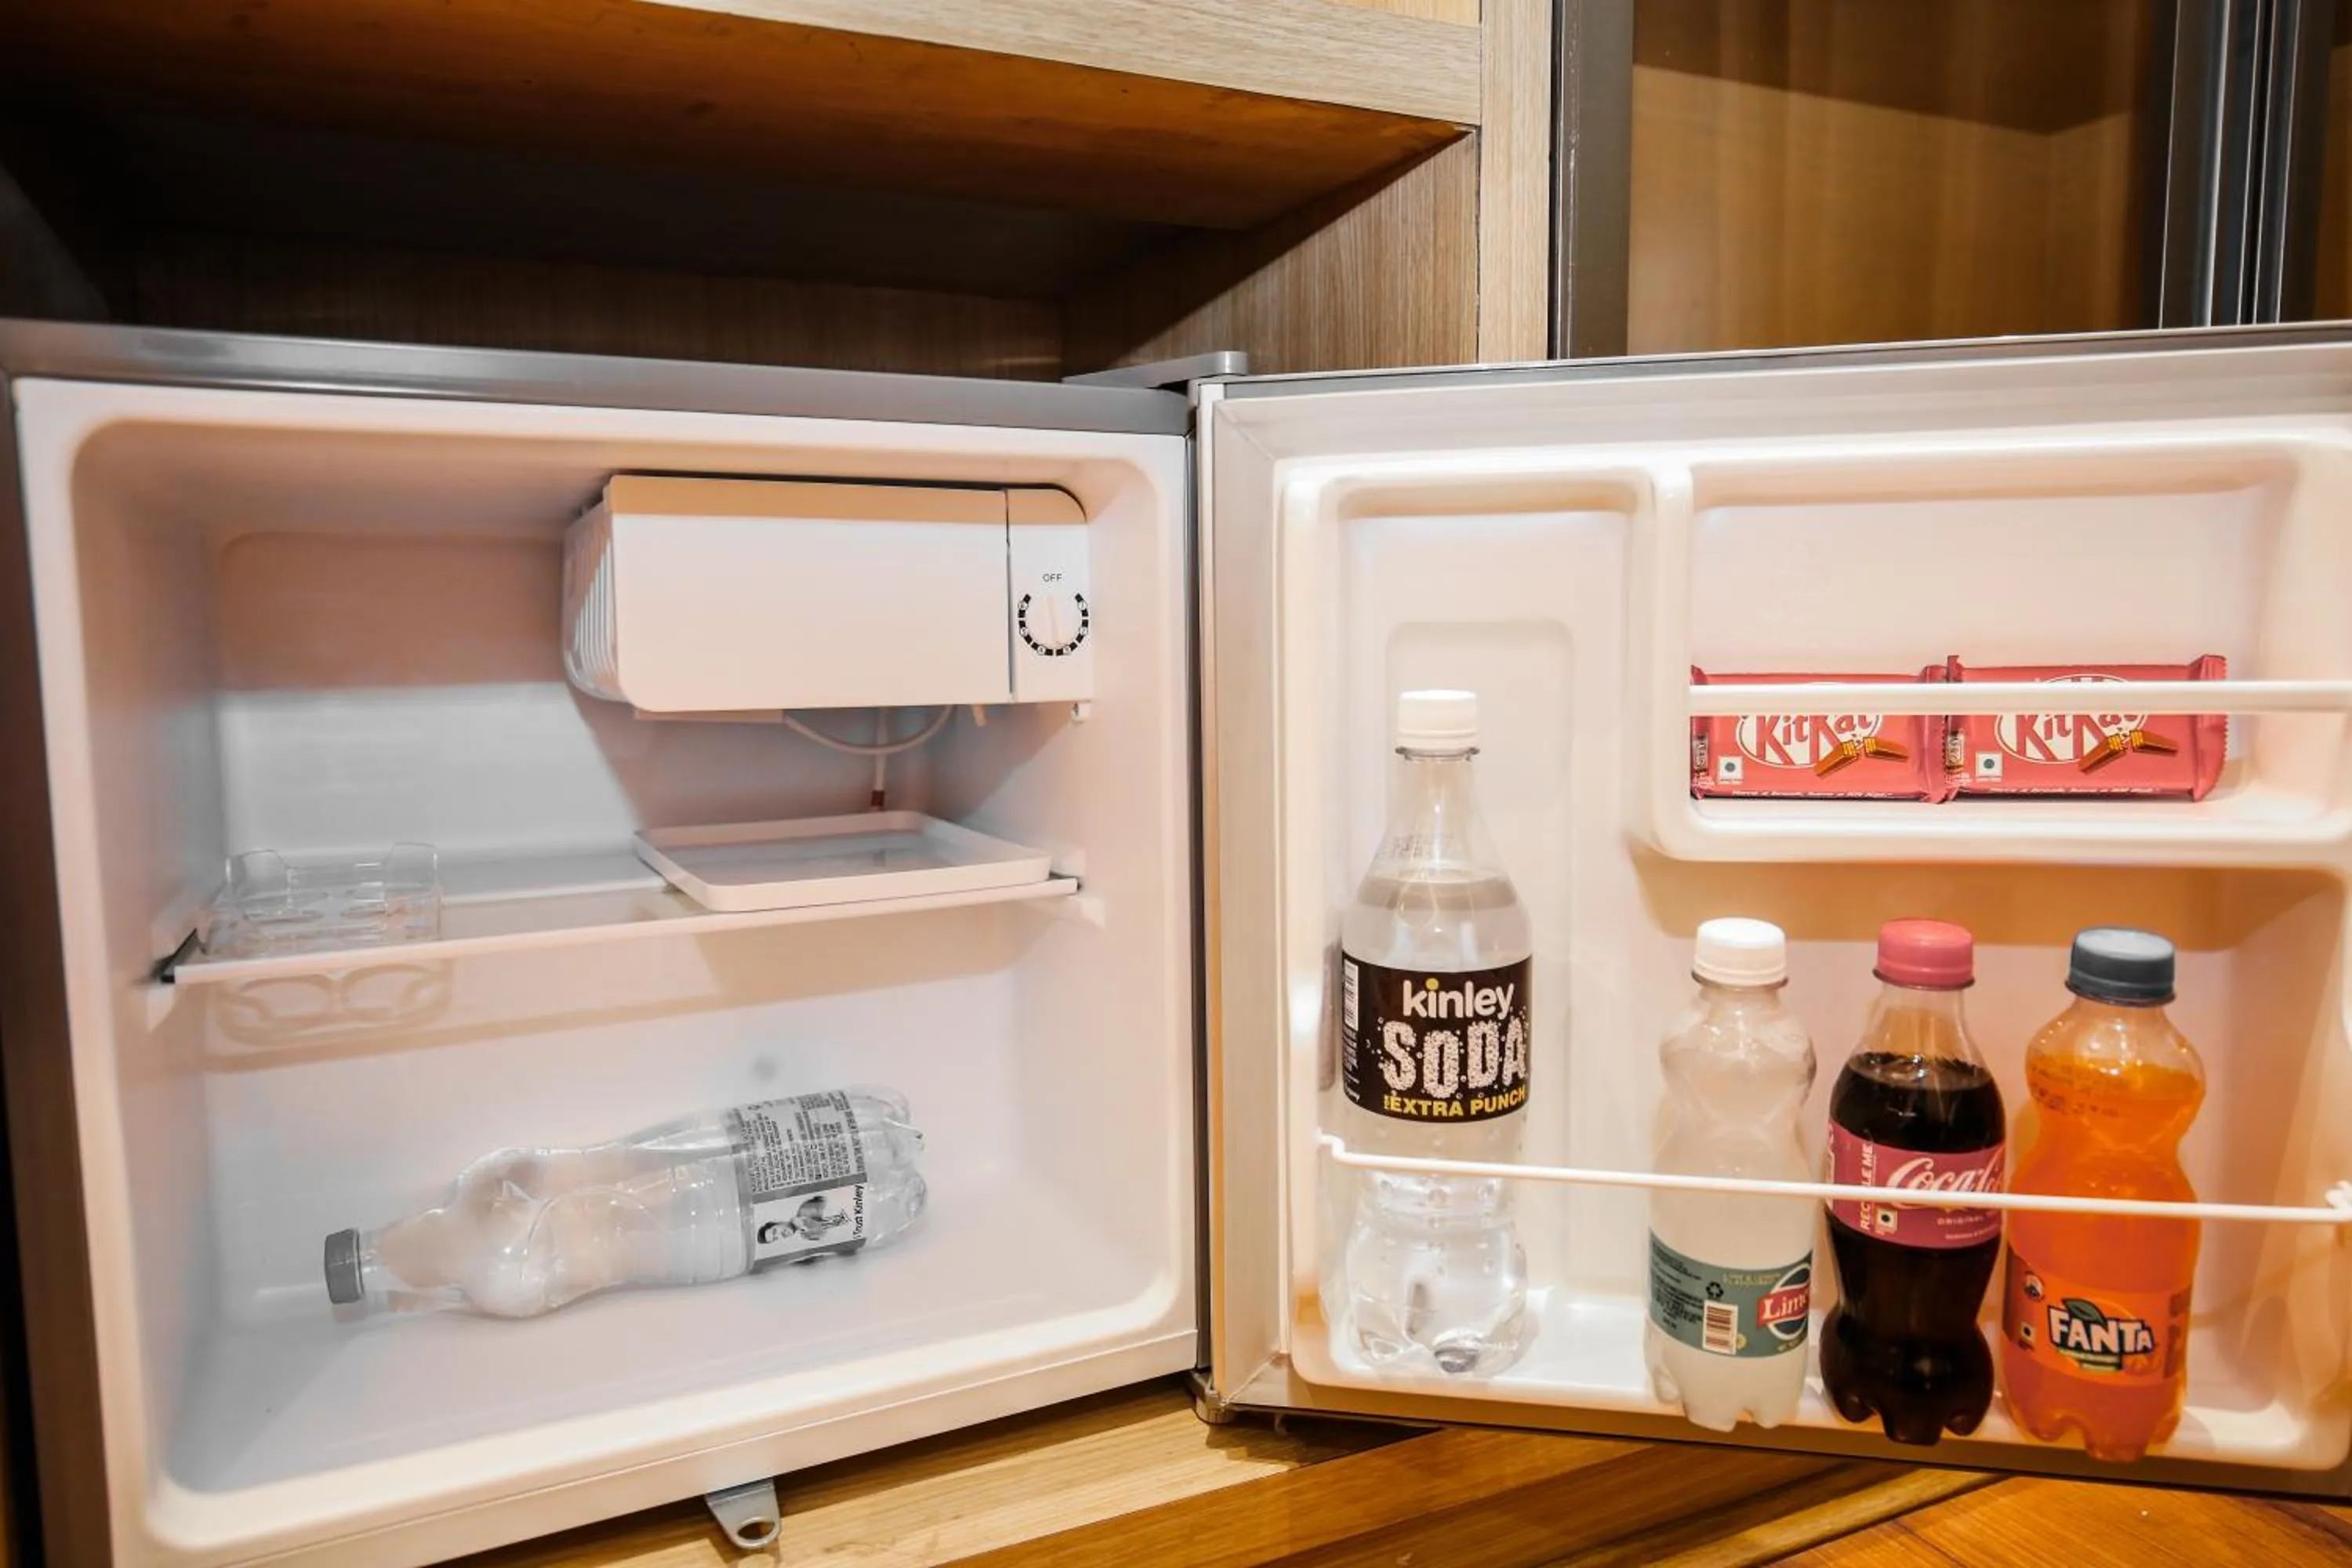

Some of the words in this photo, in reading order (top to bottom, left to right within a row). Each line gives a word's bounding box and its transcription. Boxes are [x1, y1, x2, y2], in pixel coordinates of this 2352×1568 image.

[1042, 573, 1062, 583] OFF
[2016, 674, 2137, 760] KitKa
[1403, 978, 1514, 1019] kinley
[1381, 1018, 1526, 1099] SODA
[1470, 1084, 1526, 1116] PUNCH
[1861, 1142, 1873, 1167] ME
[853, 1185, 864, 1214] Kinley
[1859, 1167, 1871, 1231] RECLE
[2048, 1307, 2153, 1354] FANTA
